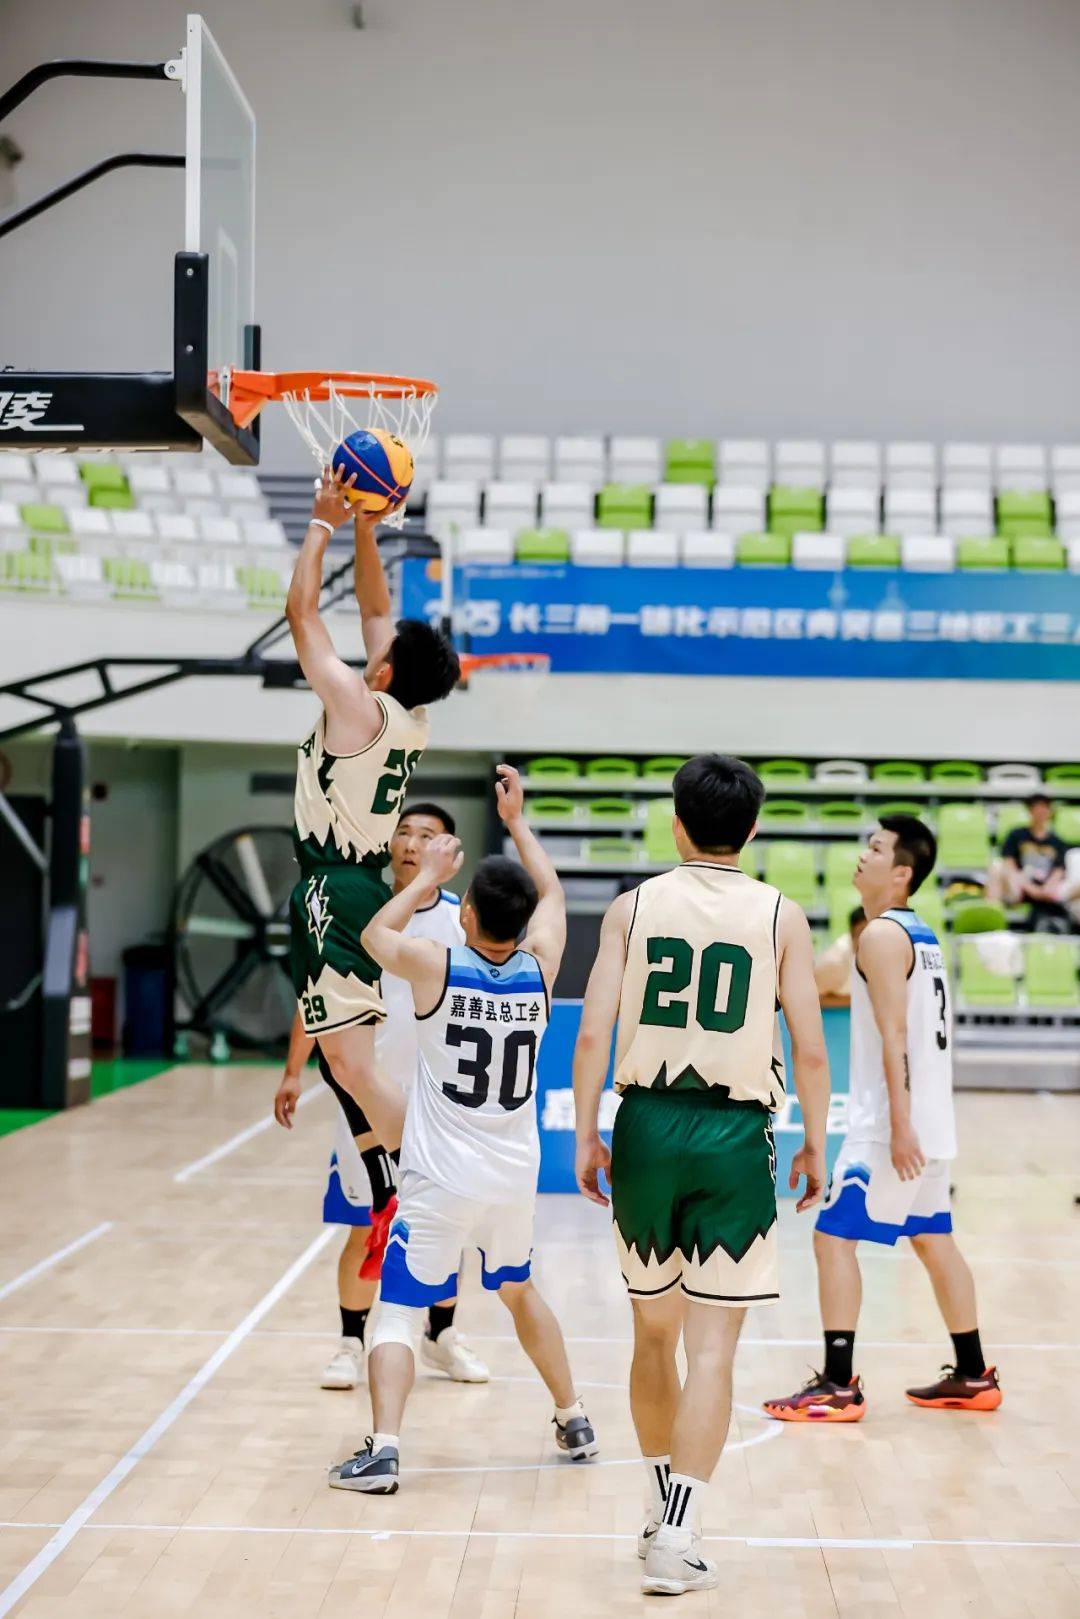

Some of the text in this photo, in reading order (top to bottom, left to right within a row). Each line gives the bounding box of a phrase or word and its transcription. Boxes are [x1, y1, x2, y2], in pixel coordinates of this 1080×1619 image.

[508, 601, 1080, 645] 长三一化示区三工三
[639, 936, 752, 1034] 20
[302, 994, 327, 1025] 29
[450, 994, 540, 1023] 嘉善县总工会
[442, 1023, 537, 1111] 30
